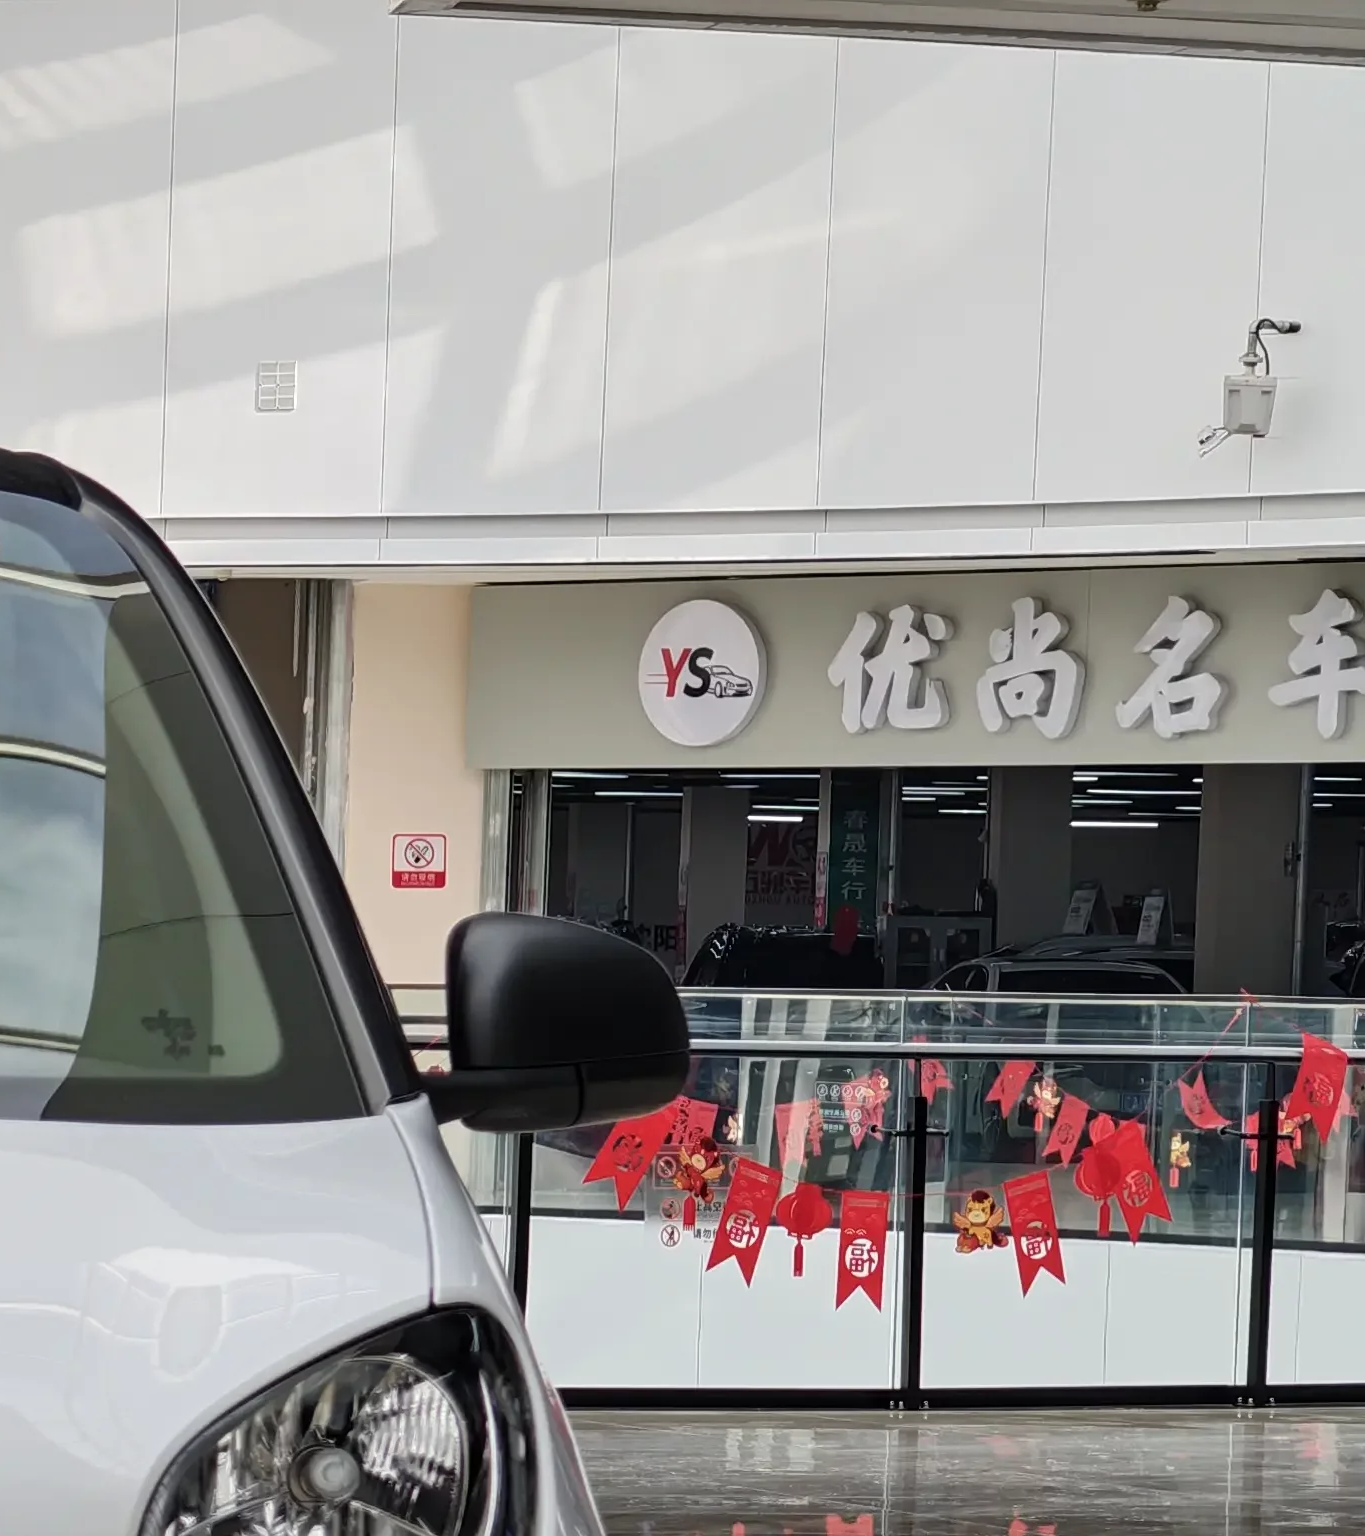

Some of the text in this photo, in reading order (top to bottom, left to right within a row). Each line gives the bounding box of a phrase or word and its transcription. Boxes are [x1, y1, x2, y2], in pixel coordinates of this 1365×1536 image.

[660, 647, 714, 698] YS
[827, 588, 1365, 740] 优尚名车
[1121, 1170, 1153, 1207] 福
